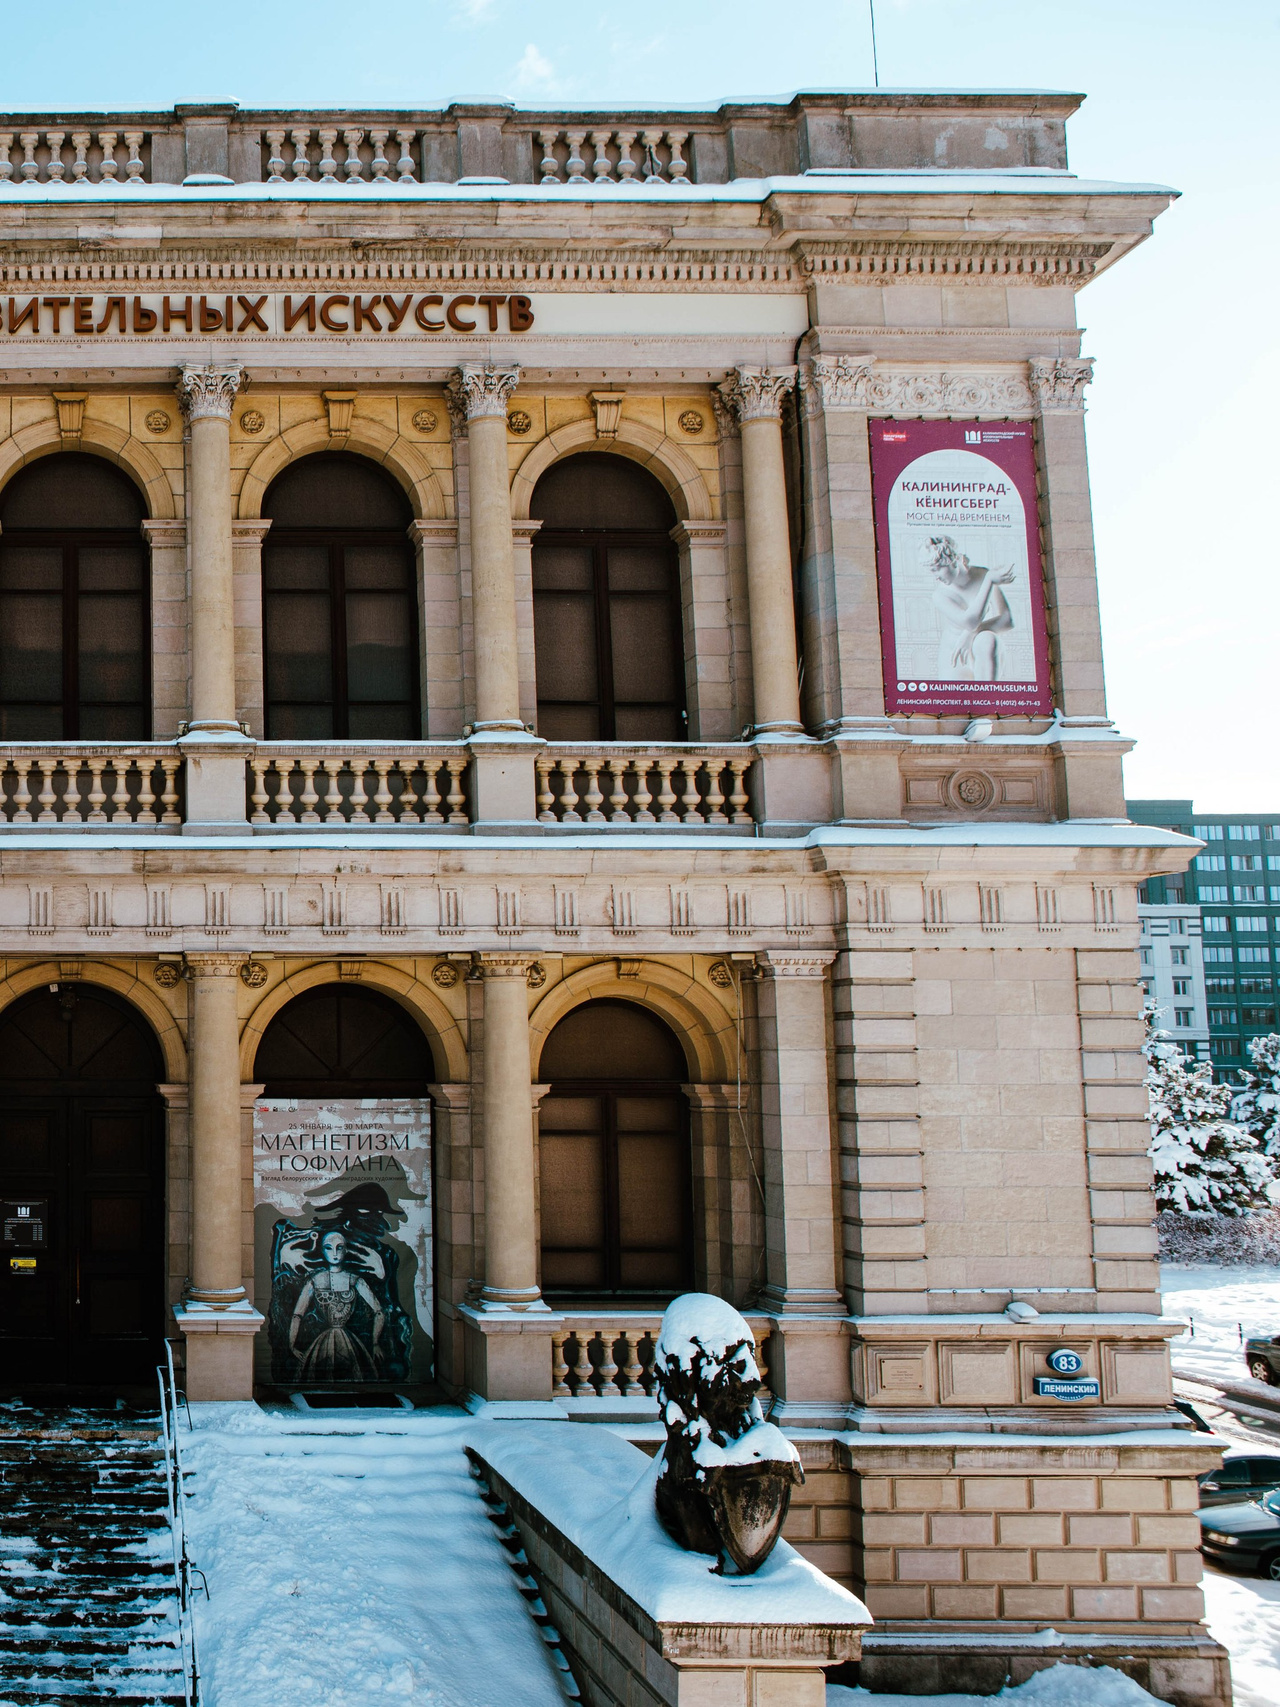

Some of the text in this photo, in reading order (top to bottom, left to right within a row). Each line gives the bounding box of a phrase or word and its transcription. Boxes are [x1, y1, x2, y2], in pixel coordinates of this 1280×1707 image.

[283, 294, 535, 333] ИСКУССТВ
[902, 481, 1011, 496] КАЛИНИНГРАД-
[915, 495, 1000, 509] КЁНИГСБЕРГ
[906, 512, 1011, 523] МОСТ НАД ВРЕМЕНЕМ
[928, 683, 1039, 693] KALININGRADARTMUSEUM.RU
[896, 698, 932, 706] ЛЕНИНСКИЙ
[261, 1134, 410, 1151] МАГНЕТИЗМ
[279, 1154, 400, 1172] ГОФМАНА
[1059, 1356, 1077, 1370] 83
[1044, 1384, 1096, 1393] ЛЕНИНСКИЙ
